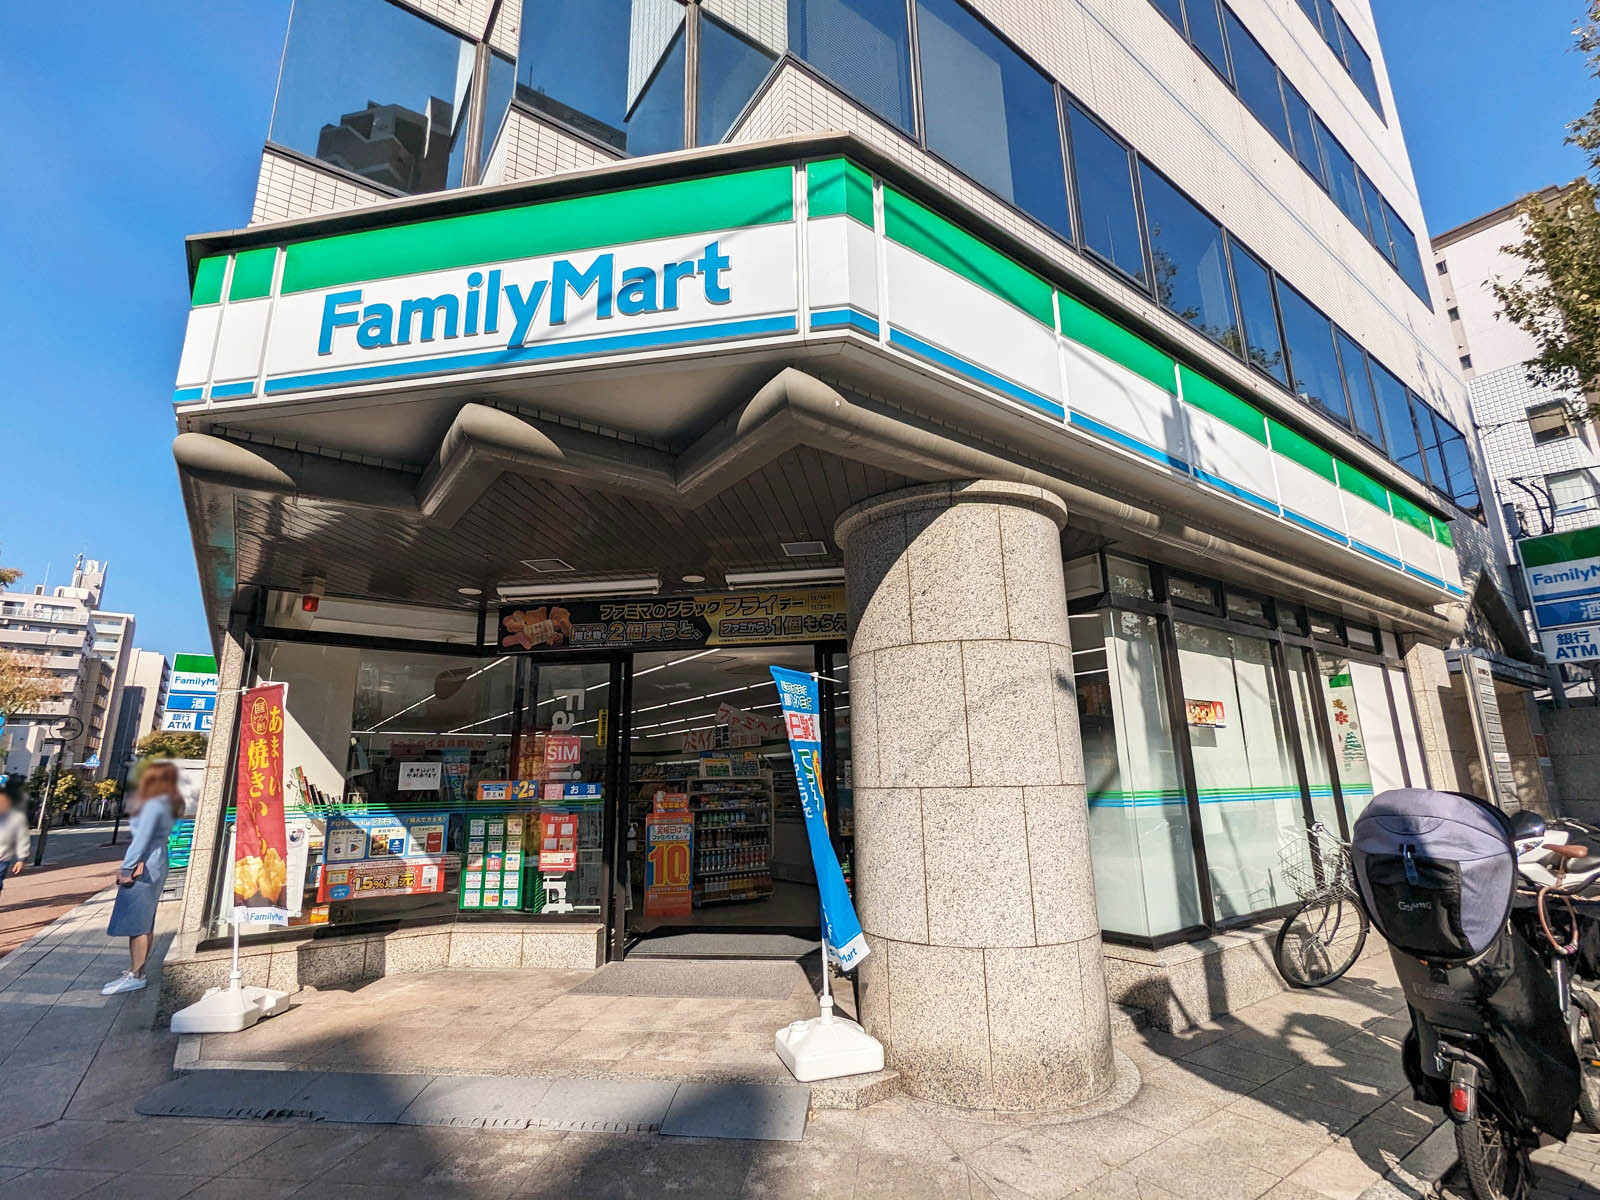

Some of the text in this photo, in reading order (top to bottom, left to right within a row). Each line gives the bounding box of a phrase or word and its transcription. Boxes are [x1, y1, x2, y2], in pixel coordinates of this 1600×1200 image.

[318, 240, 732, 356] FamilyMart
[1580, 601, 1600, 620] 酒
[1556, 630, 1591, 646] 銀行
[1556, 643, 1599, 660] ATM
[191, 697, 206, 710] 酒
[167, 721, 191, 729] ATM
[172, 713, 191, 721] 銀行
[547, 744, 578, 761] SIM
[569, 783, 596, 794] お酒
